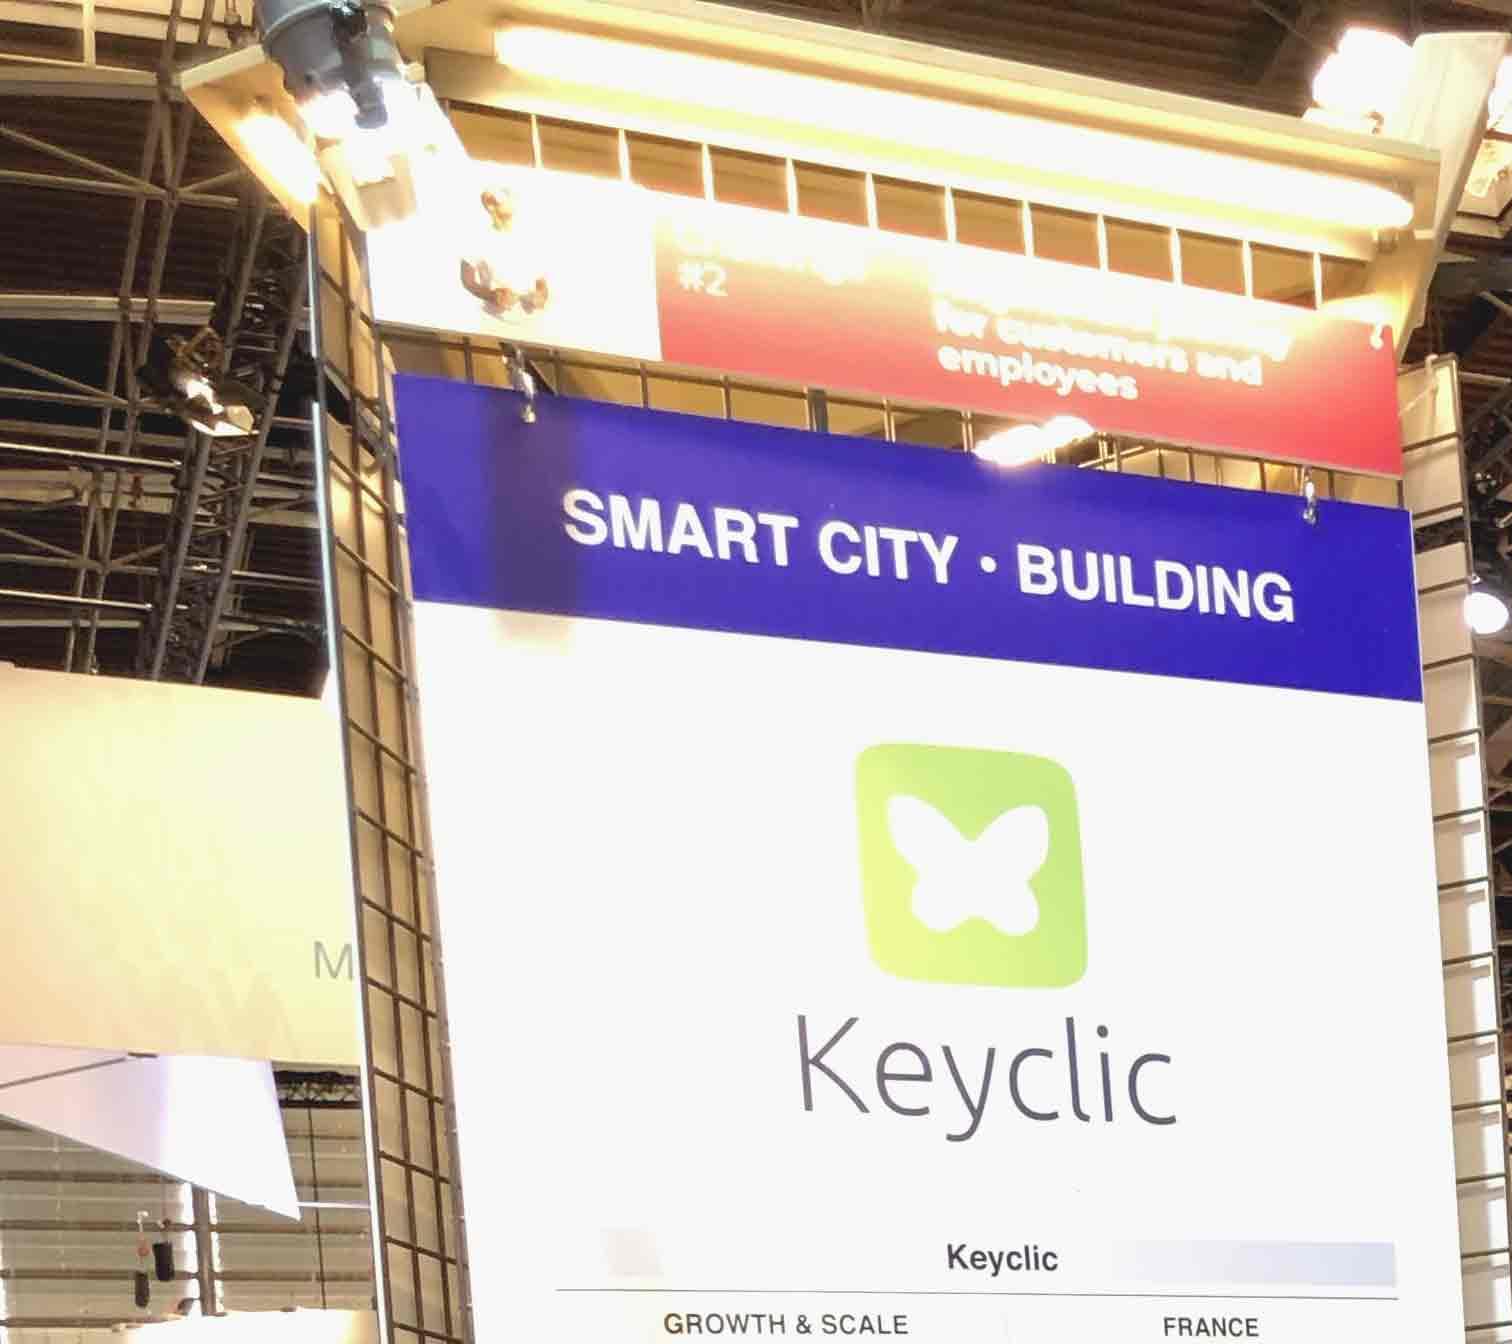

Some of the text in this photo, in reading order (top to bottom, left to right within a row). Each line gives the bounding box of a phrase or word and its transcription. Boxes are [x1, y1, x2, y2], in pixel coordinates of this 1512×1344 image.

[938, 345, 1138, 400] employees
[563, 489, 1296, 623] SMART CITY BUILDING
[797, 1014, 1177, 1143] Keyclic
[946, 1243, 1059, 1278] Keyclic
[664, 1313, 1259, 1337] GROWTH & SCALE FRANCE
